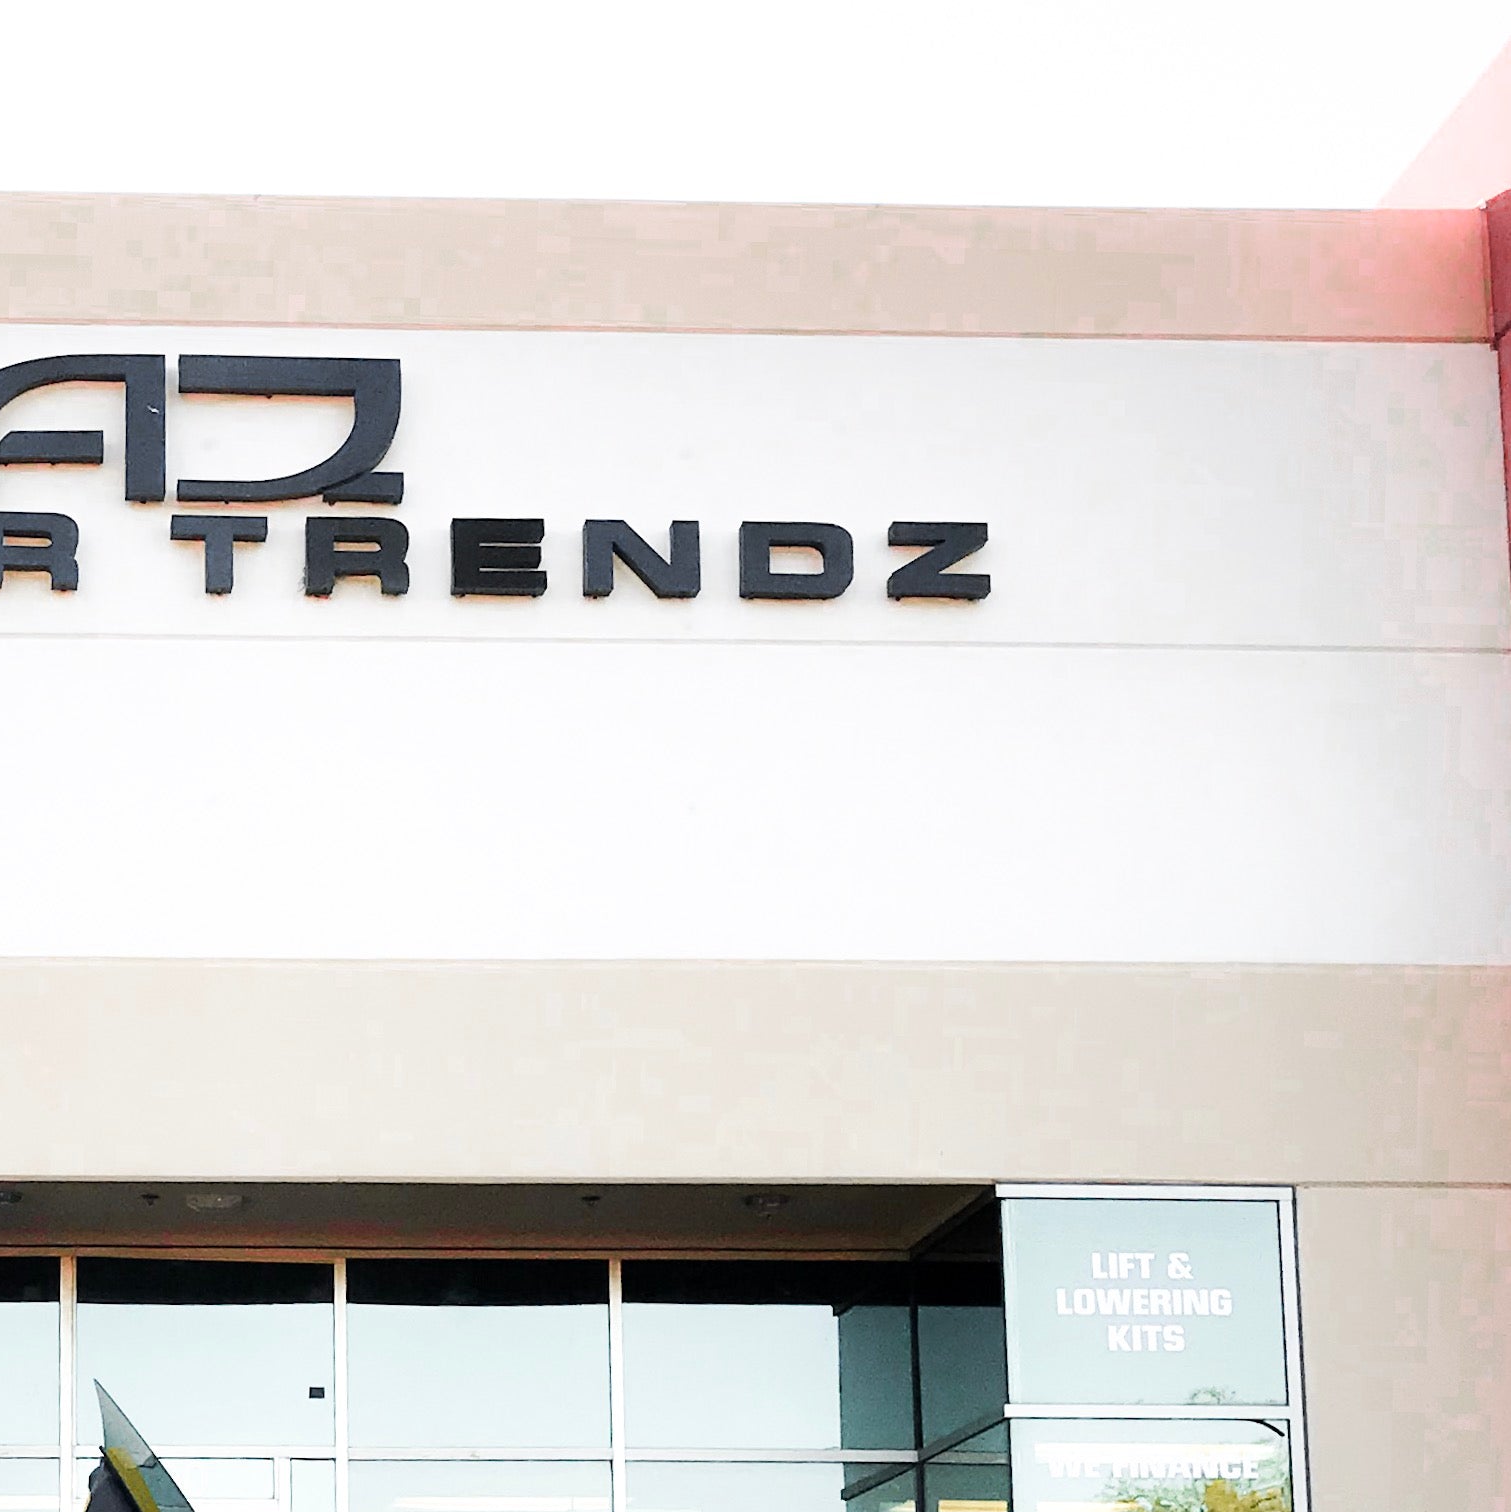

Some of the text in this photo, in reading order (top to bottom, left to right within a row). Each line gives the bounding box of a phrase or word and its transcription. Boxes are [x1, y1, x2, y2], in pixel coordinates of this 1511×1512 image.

[170, 514, 992, 600] TRENDZ
[1091, 1252, 1194, 1279] LIFT &
[1055, 1287, 1233, 1316] LOWERING
[1107, 1324, 1185, 1352] KITS
